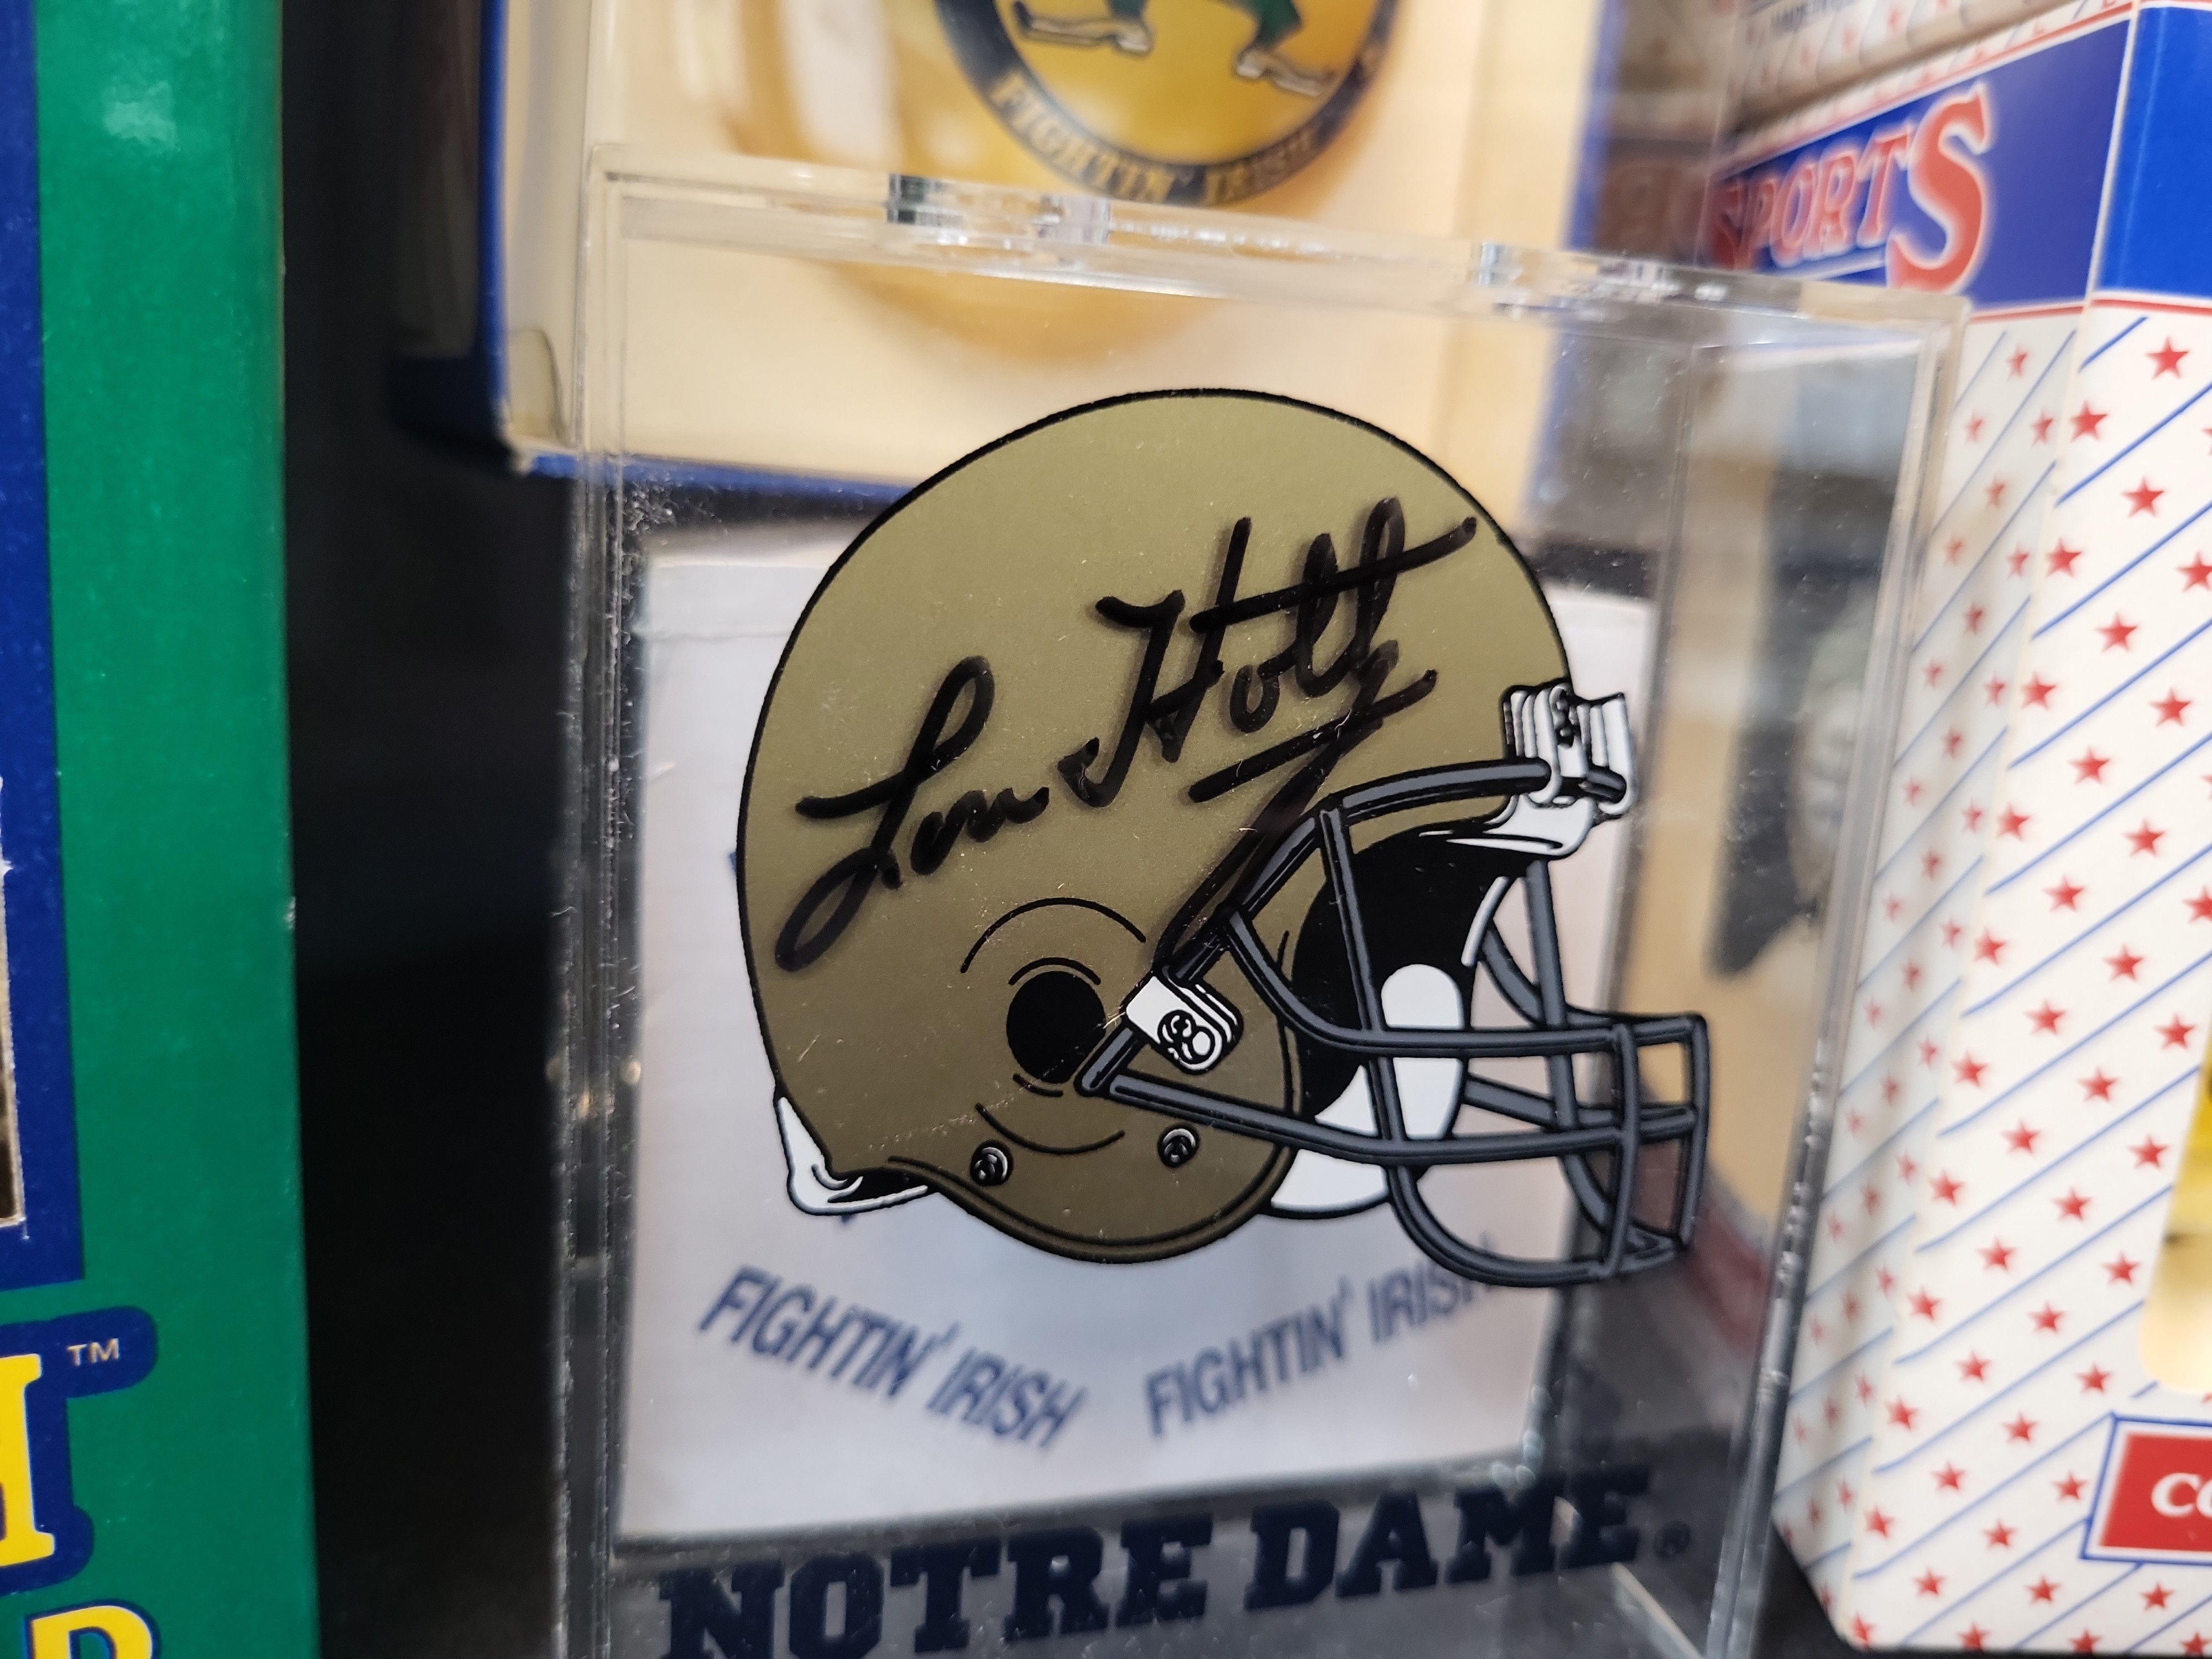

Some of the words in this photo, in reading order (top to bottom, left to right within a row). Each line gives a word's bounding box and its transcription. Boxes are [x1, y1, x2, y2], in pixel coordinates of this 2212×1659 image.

[67, 1337, 120, 1368] TM
[698, 1264, 962, 1400] FIGHTIN'
[925, 1346, 1088, 1449] IRISH
[1145, 1275, 1354, 1433] FIGHTIN'
[658, 1512, 1214, 1659] NOTRE
